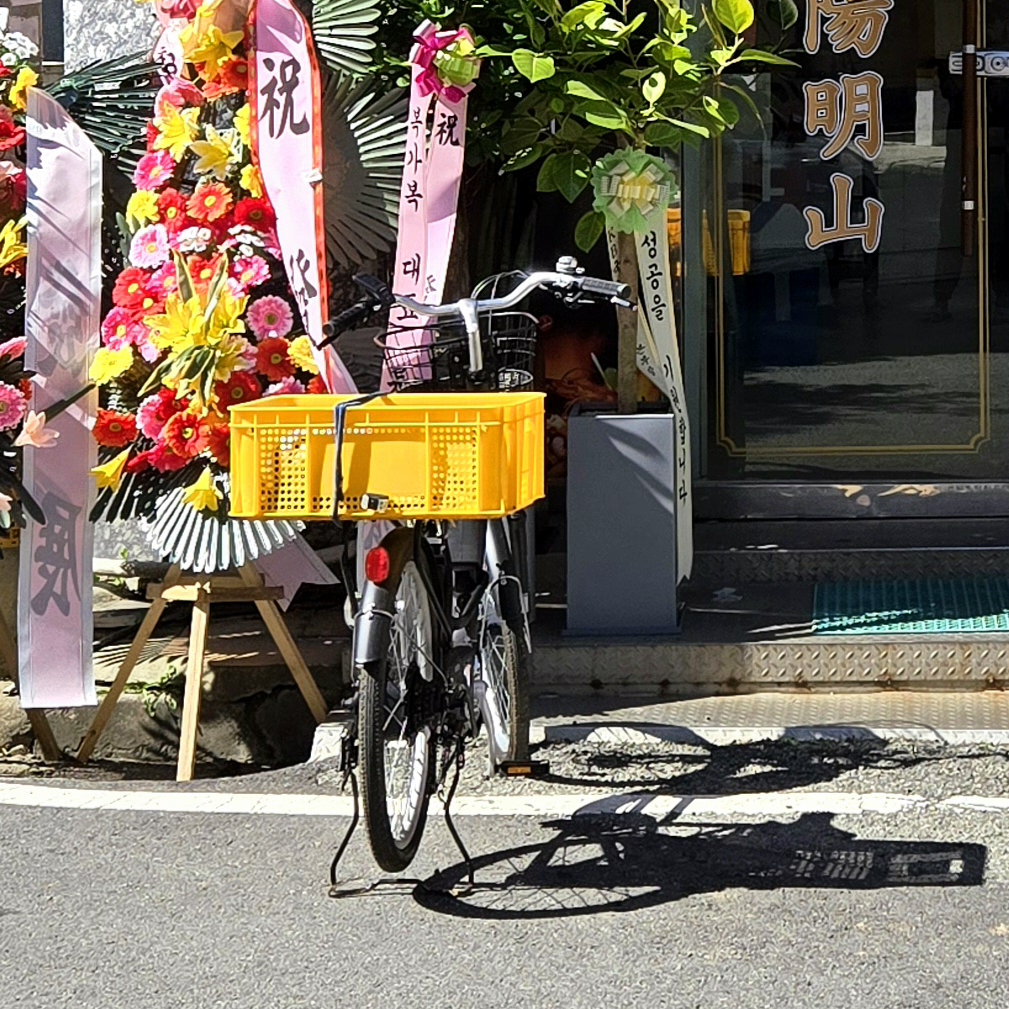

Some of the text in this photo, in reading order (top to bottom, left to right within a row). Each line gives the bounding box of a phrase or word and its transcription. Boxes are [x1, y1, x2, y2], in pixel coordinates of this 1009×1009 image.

[258, 57, 310, 139] 祝
[434, 112, 460, 147] 祝
[641, 230, 666, 321] 성공을
